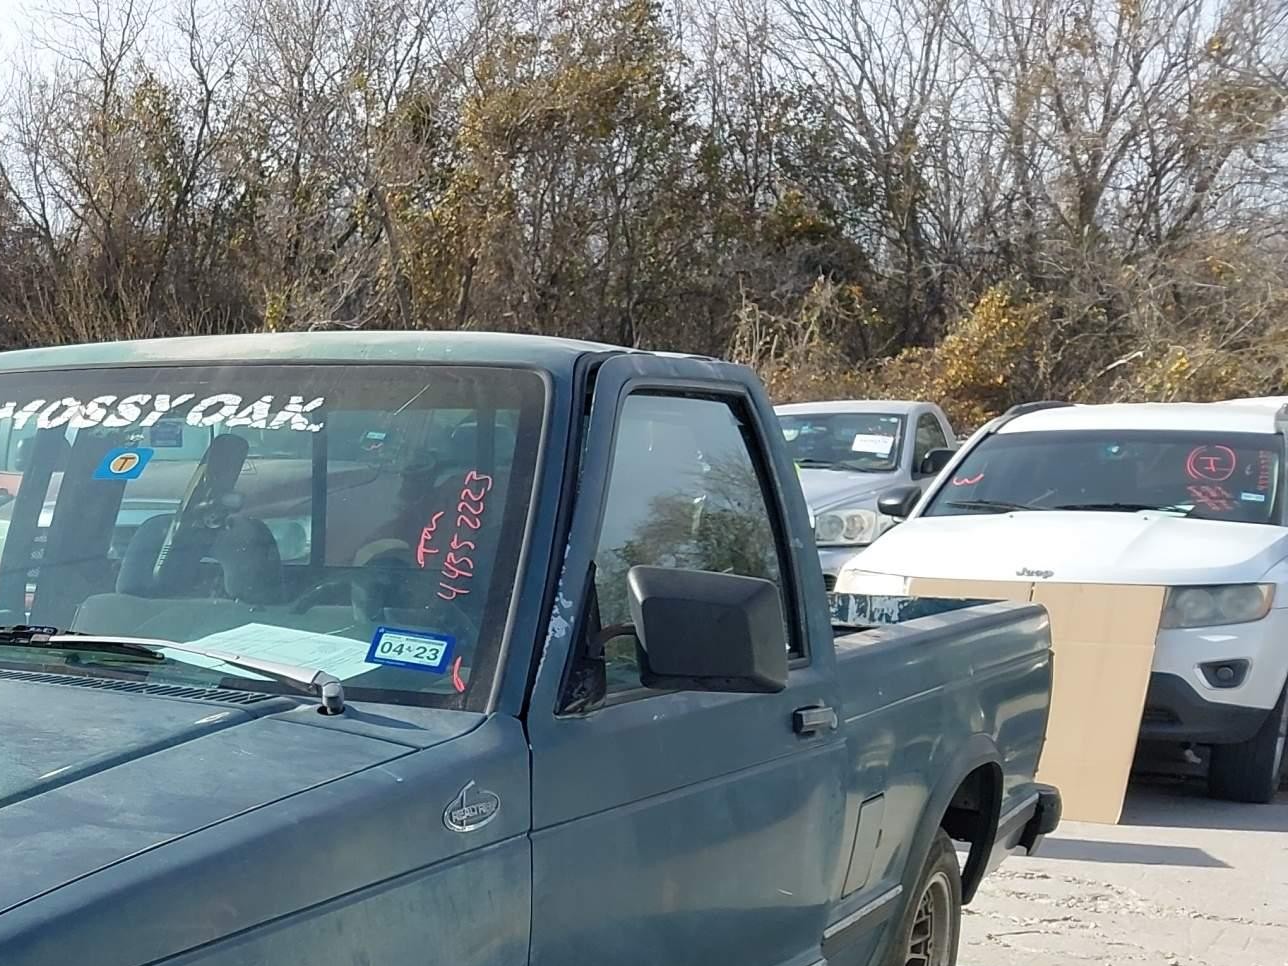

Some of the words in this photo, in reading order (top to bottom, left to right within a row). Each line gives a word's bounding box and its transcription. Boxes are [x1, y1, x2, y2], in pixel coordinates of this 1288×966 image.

[186, 393, 327, 433] OAK
[380, 641, 405, 656] 04
[413, 646, 440, 661] 23
